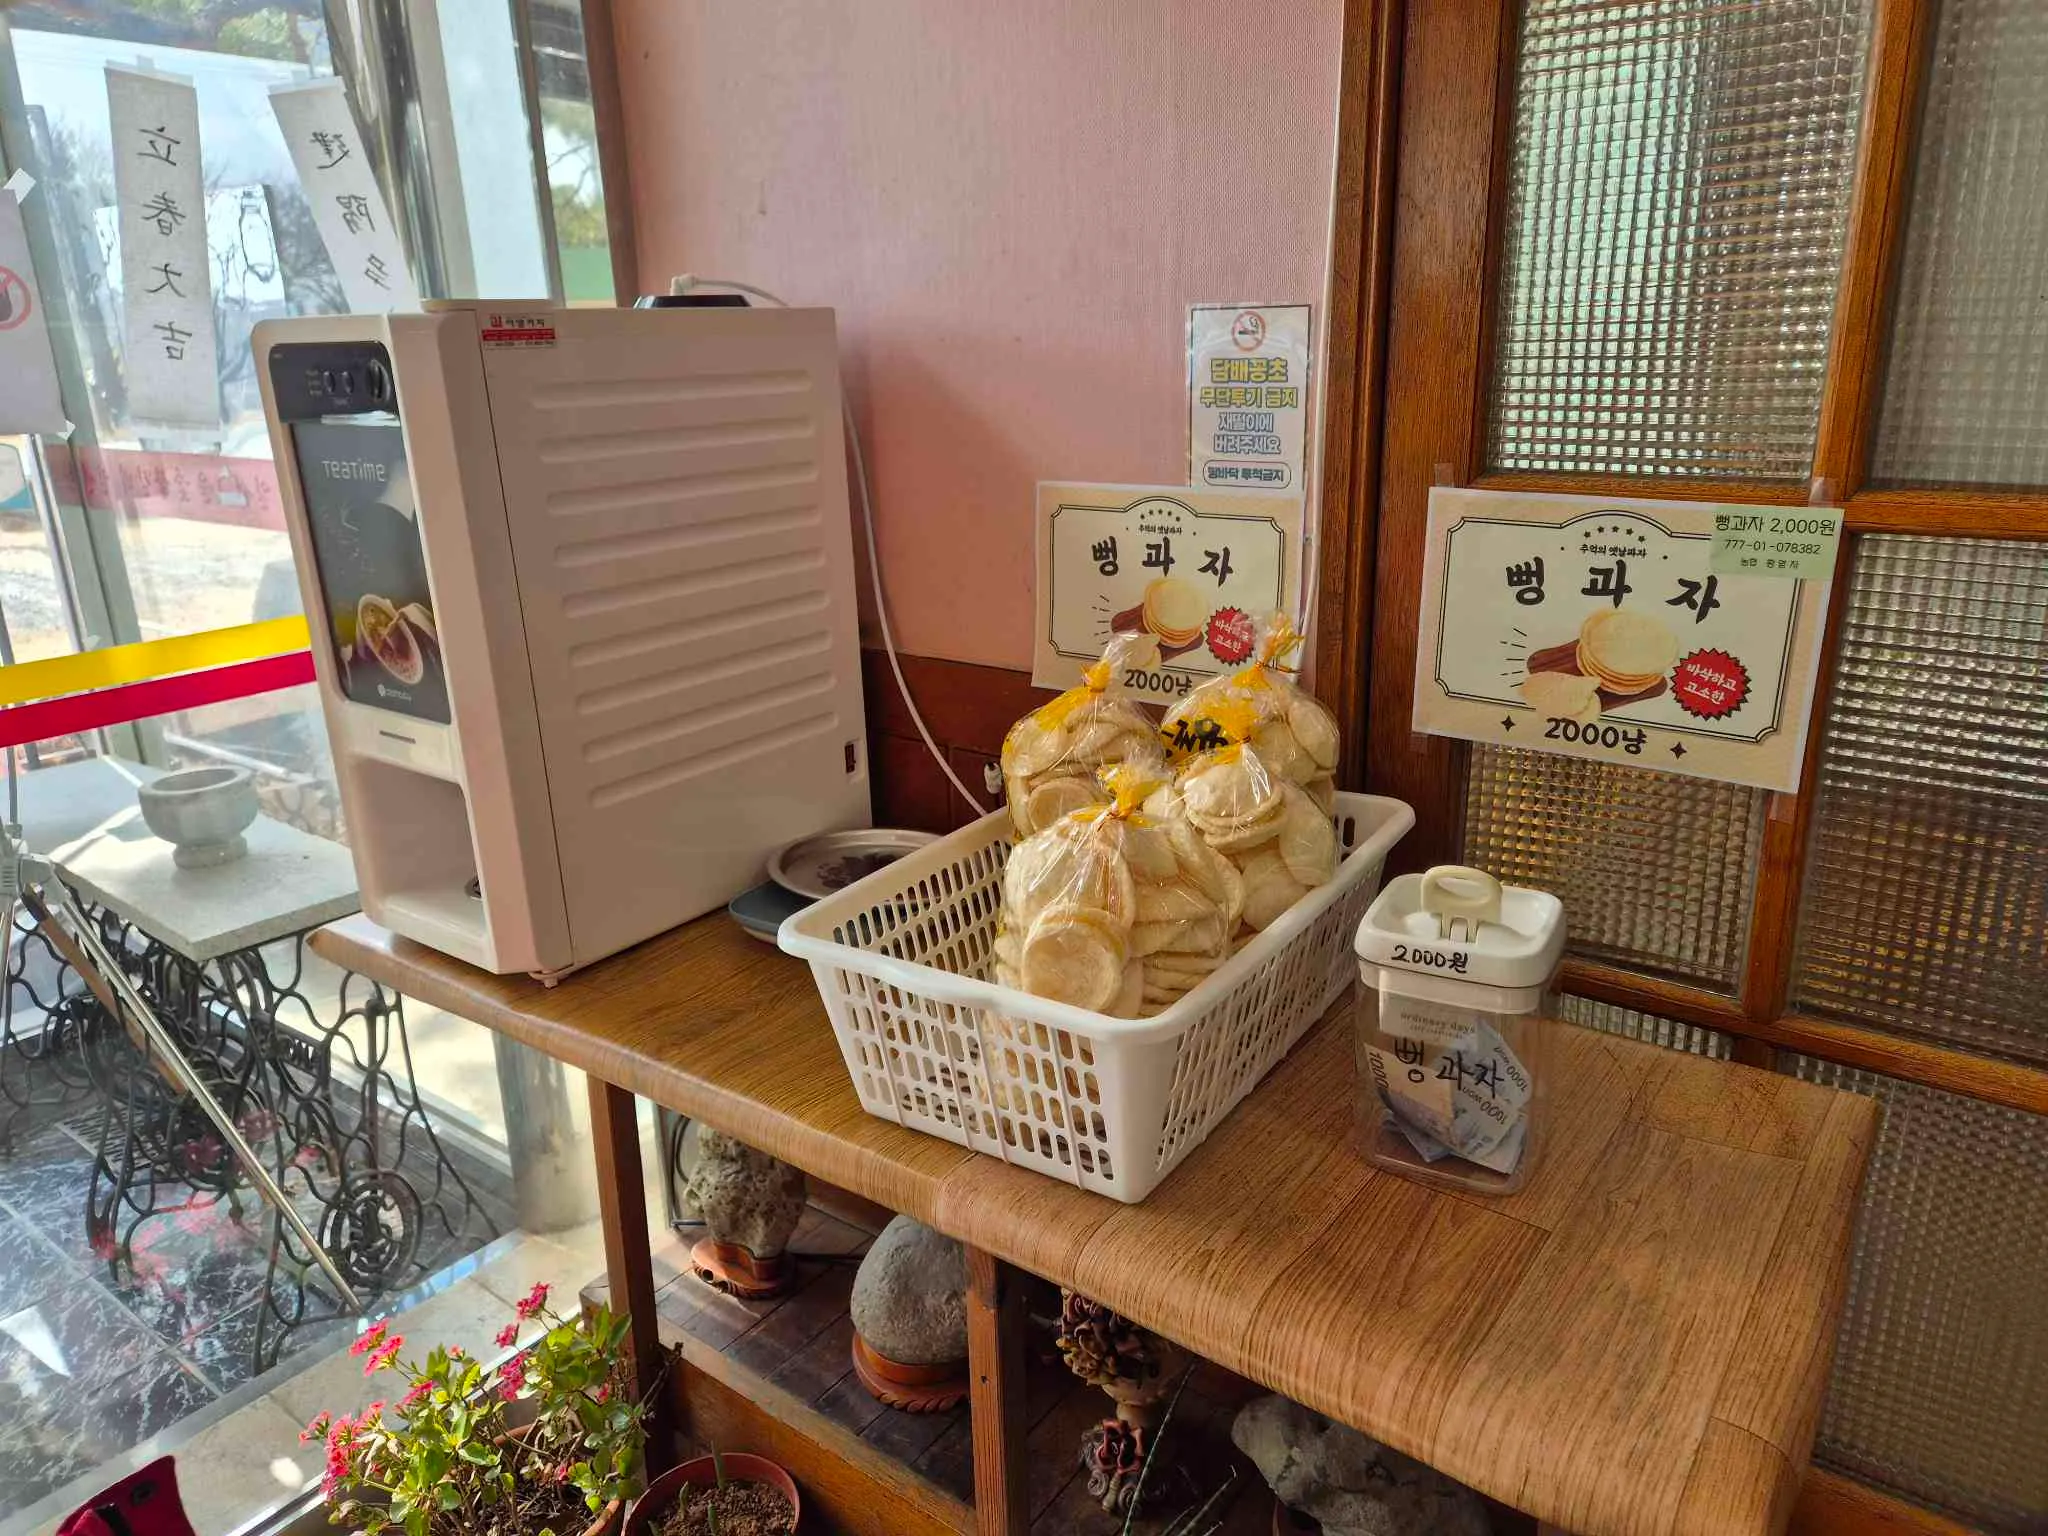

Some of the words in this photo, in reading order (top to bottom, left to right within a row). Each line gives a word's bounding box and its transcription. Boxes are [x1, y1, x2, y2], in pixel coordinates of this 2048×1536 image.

[1210, 357, 1288, 383] 담배꽁초
[1200, 386, 1262, 408] 무단투기
[1265, 387, 1298, 408] 금지
[1219, 412, 1273, 432] 재떨이에
[1214, 434, 1281, 454] 버려주세요
[1770, 518, 1836, 536] 2,000원
[1724, 540, 1821, 555] 777-01-078382
[1124, 669, 1193, 697] 2000냥
[1686, 663, 1737, 692] 바삭하고
[1683, 681, 1725, 705] 고소한
[1545, 717, 1647, 755] 2000냥
